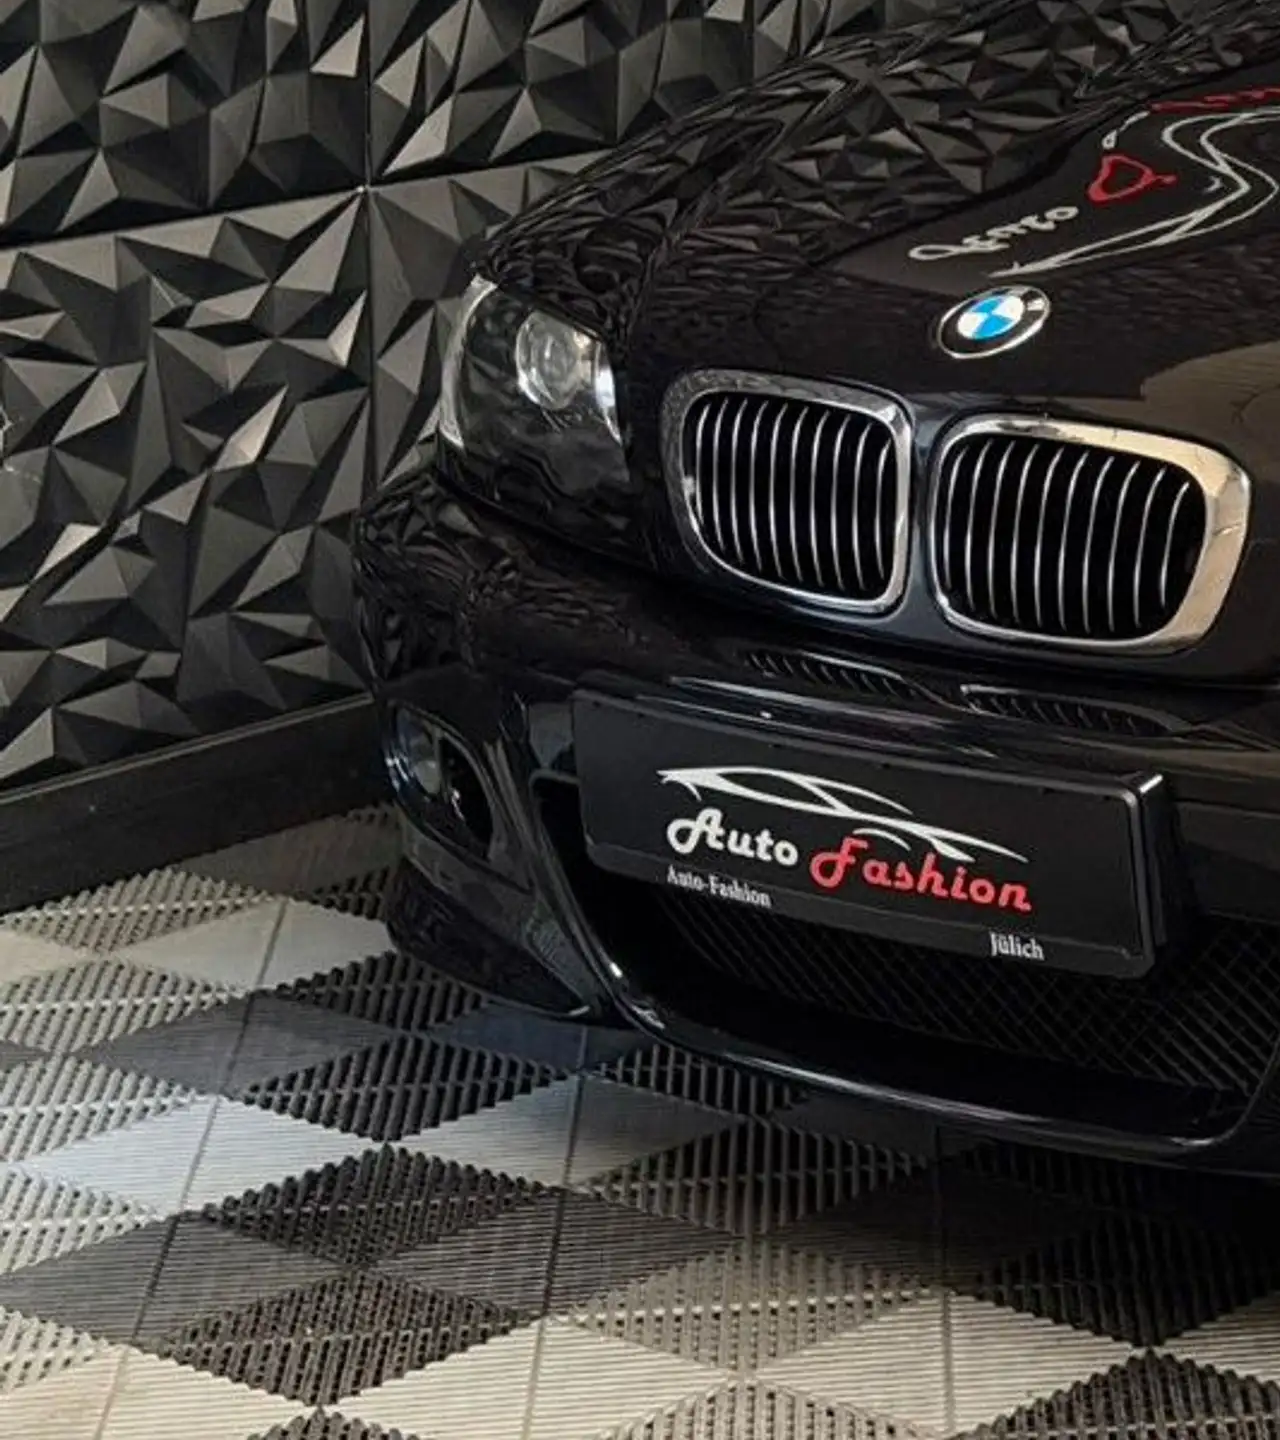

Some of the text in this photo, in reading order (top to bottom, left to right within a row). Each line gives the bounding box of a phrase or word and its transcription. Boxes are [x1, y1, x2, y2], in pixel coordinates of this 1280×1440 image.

[666, 807, 1033, 913] Auto Fashion
[667, 864, 772, 909] Auto-Fashion
[990, 931, 1045, 961] Jülich
